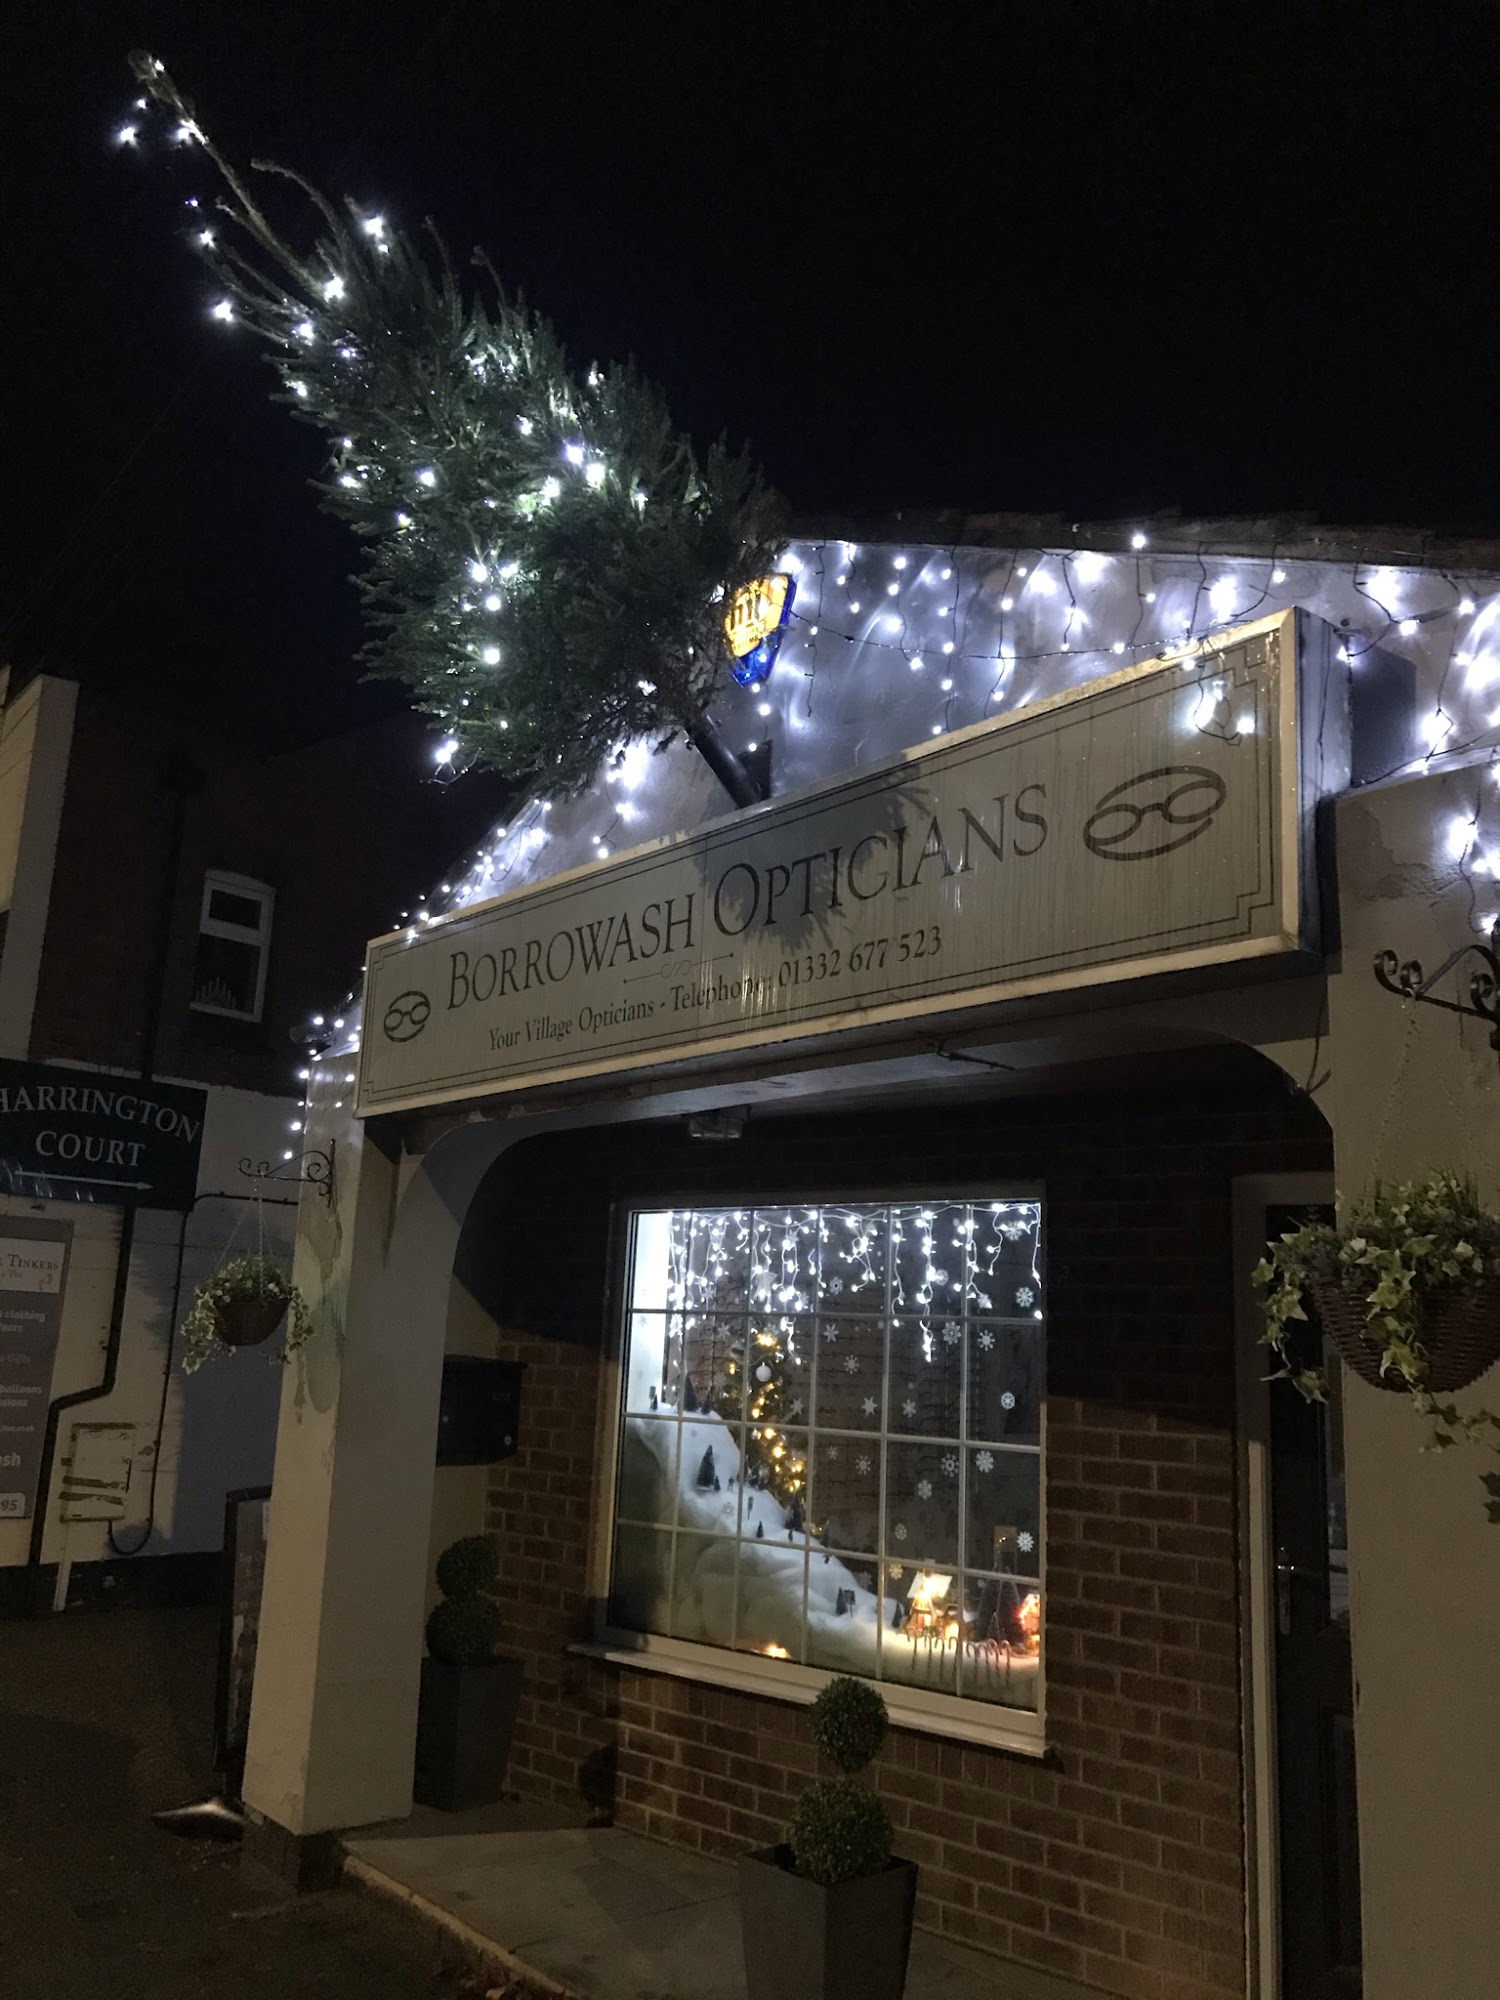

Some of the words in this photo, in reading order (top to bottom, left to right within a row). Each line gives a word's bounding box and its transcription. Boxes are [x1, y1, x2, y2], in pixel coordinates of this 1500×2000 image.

[448, 893, 696, 1010] BORROWASH
[714, 784, 1048, 936] OPTICIANS
[489, 1028, 521, 1051] Your
[525, 1018, 573, 1044] Village
[578, 1000, 654, 1033] Opticians
[778, 950, 842, 989] 01332
[849, 937, 890, 973] 677
[899, 925, 943, 963] 523
[0, 1086, 201, 1143] HARRINGTON
[35, 1131, 146, 1166] COURT
